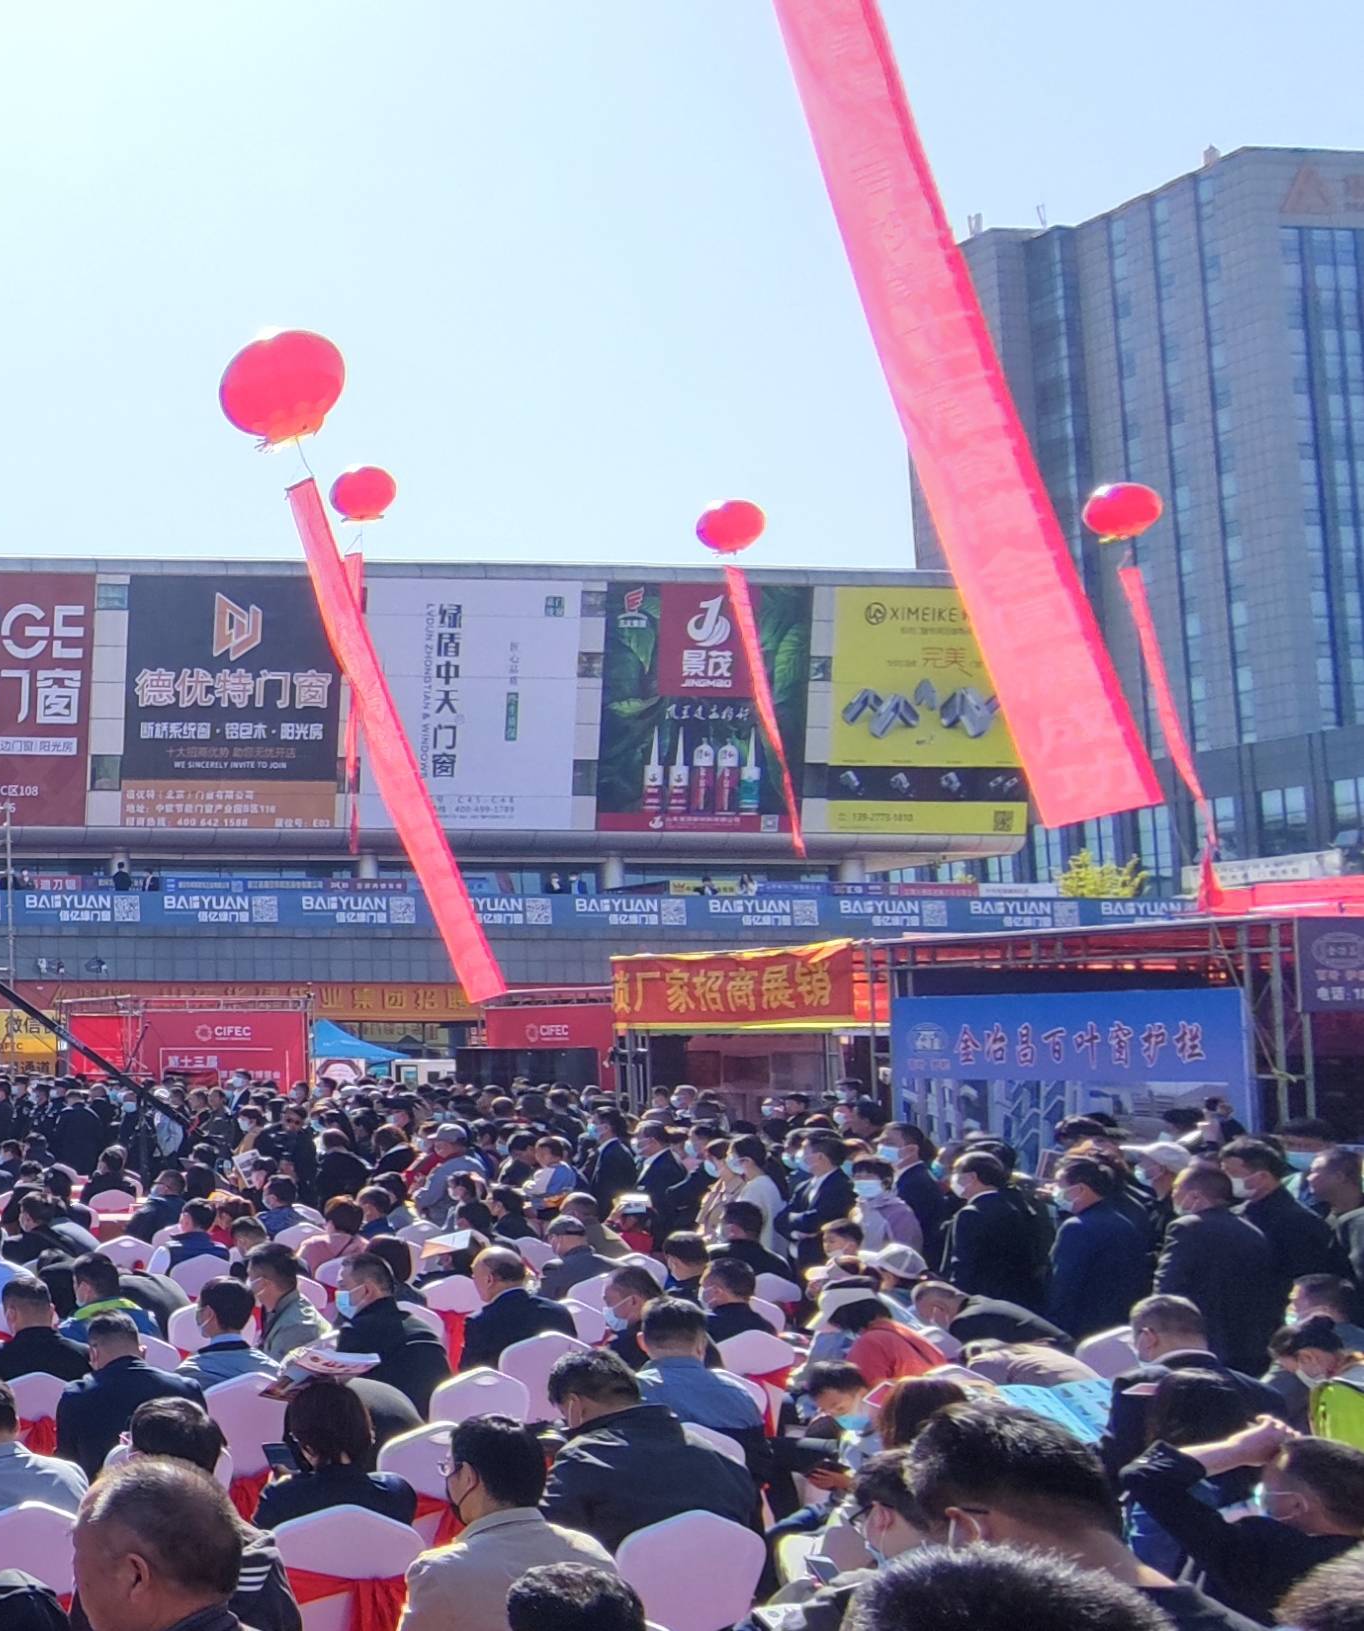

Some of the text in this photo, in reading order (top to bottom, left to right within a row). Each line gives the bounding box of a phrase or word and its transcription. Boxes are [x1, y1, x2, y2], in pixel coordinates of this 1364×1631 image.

[889, 606, 957, 623] XIMEIKE
[682, 650, 732, 677] 景茂
[922, 646, 972, 678] 完美
[134, 668, 332, 710] 德优特门窗
[432, 603, 462, 778] 绿盾中天门窗
[39, 740, 73, 753] 阳光房
[174, 760, 287, 770] WE SINCERELY INVITE TO JOIN
[215, 1026, 251, 1037] CIFEC
[540, 1024, 569, 1035] CIFEC
